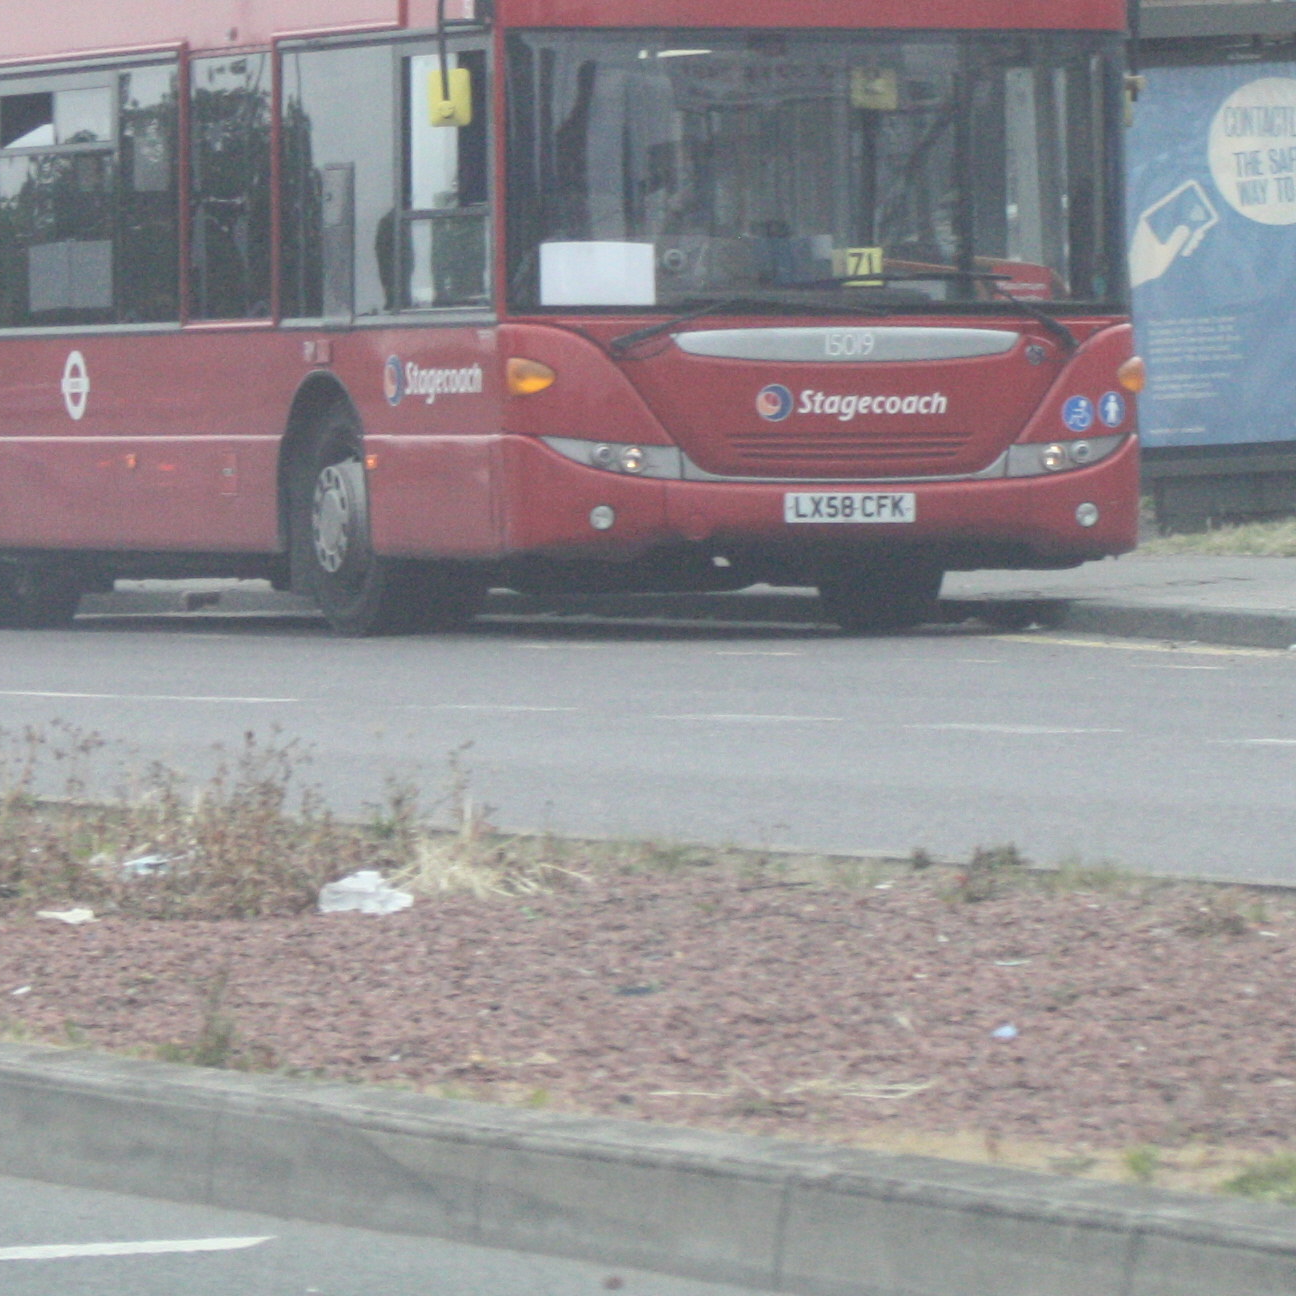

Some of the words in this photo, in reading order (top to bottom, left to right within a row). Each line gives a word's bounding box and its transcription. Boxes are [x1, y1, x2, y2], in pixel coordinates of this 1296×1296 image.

[1232, 149, 1264, 177] THE
[1236, 179, 1268, 206] WAY
[1274, 177, 1295, 202] TO
[850, 252, 874, 275] 71
[405, 362, 482, 404] Stagecoach
[798, 390, 948, 421] Stagecoach
[794, 496, 854, 518] LX58
[861, 496, 905, 518] CFK
